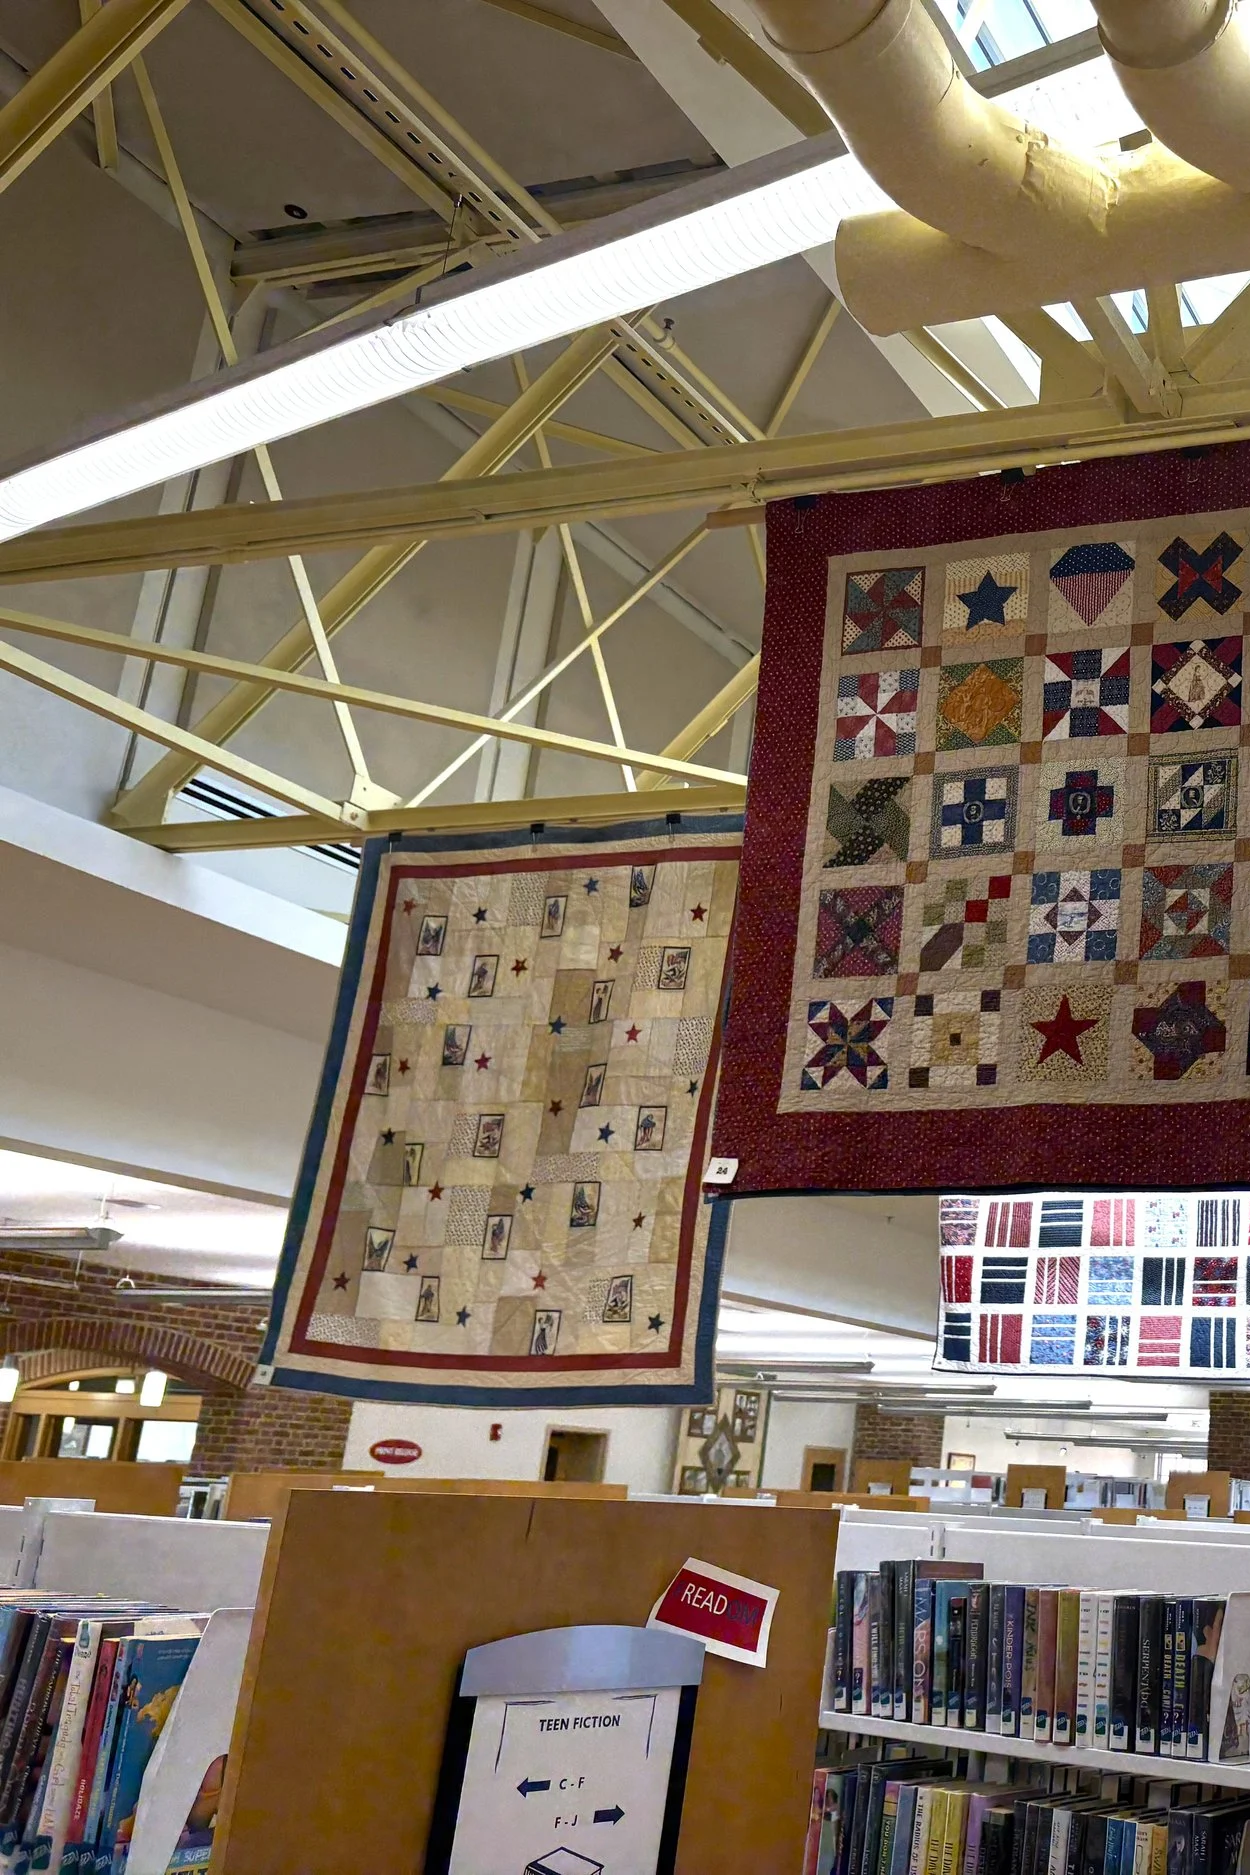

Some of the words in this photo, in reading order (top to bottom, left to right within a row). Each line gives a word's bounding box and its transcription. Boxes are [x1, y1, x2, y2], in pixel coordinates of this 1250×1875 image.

[914, 1597, 929, 1654] MARS
[1163, 1653, 1172, 1679] DEATH
[1175, 1654, 1186, 1688] DEATH
[540, 1717, 570, 1732] TEEN
[573, 1714, 621, 1730] FICTION
[73, 1778, 87, 1821] HOLIDAZE
[916, 1803, 925, 1820] THE
[912, 1820, 924, 1851] RADIUS
